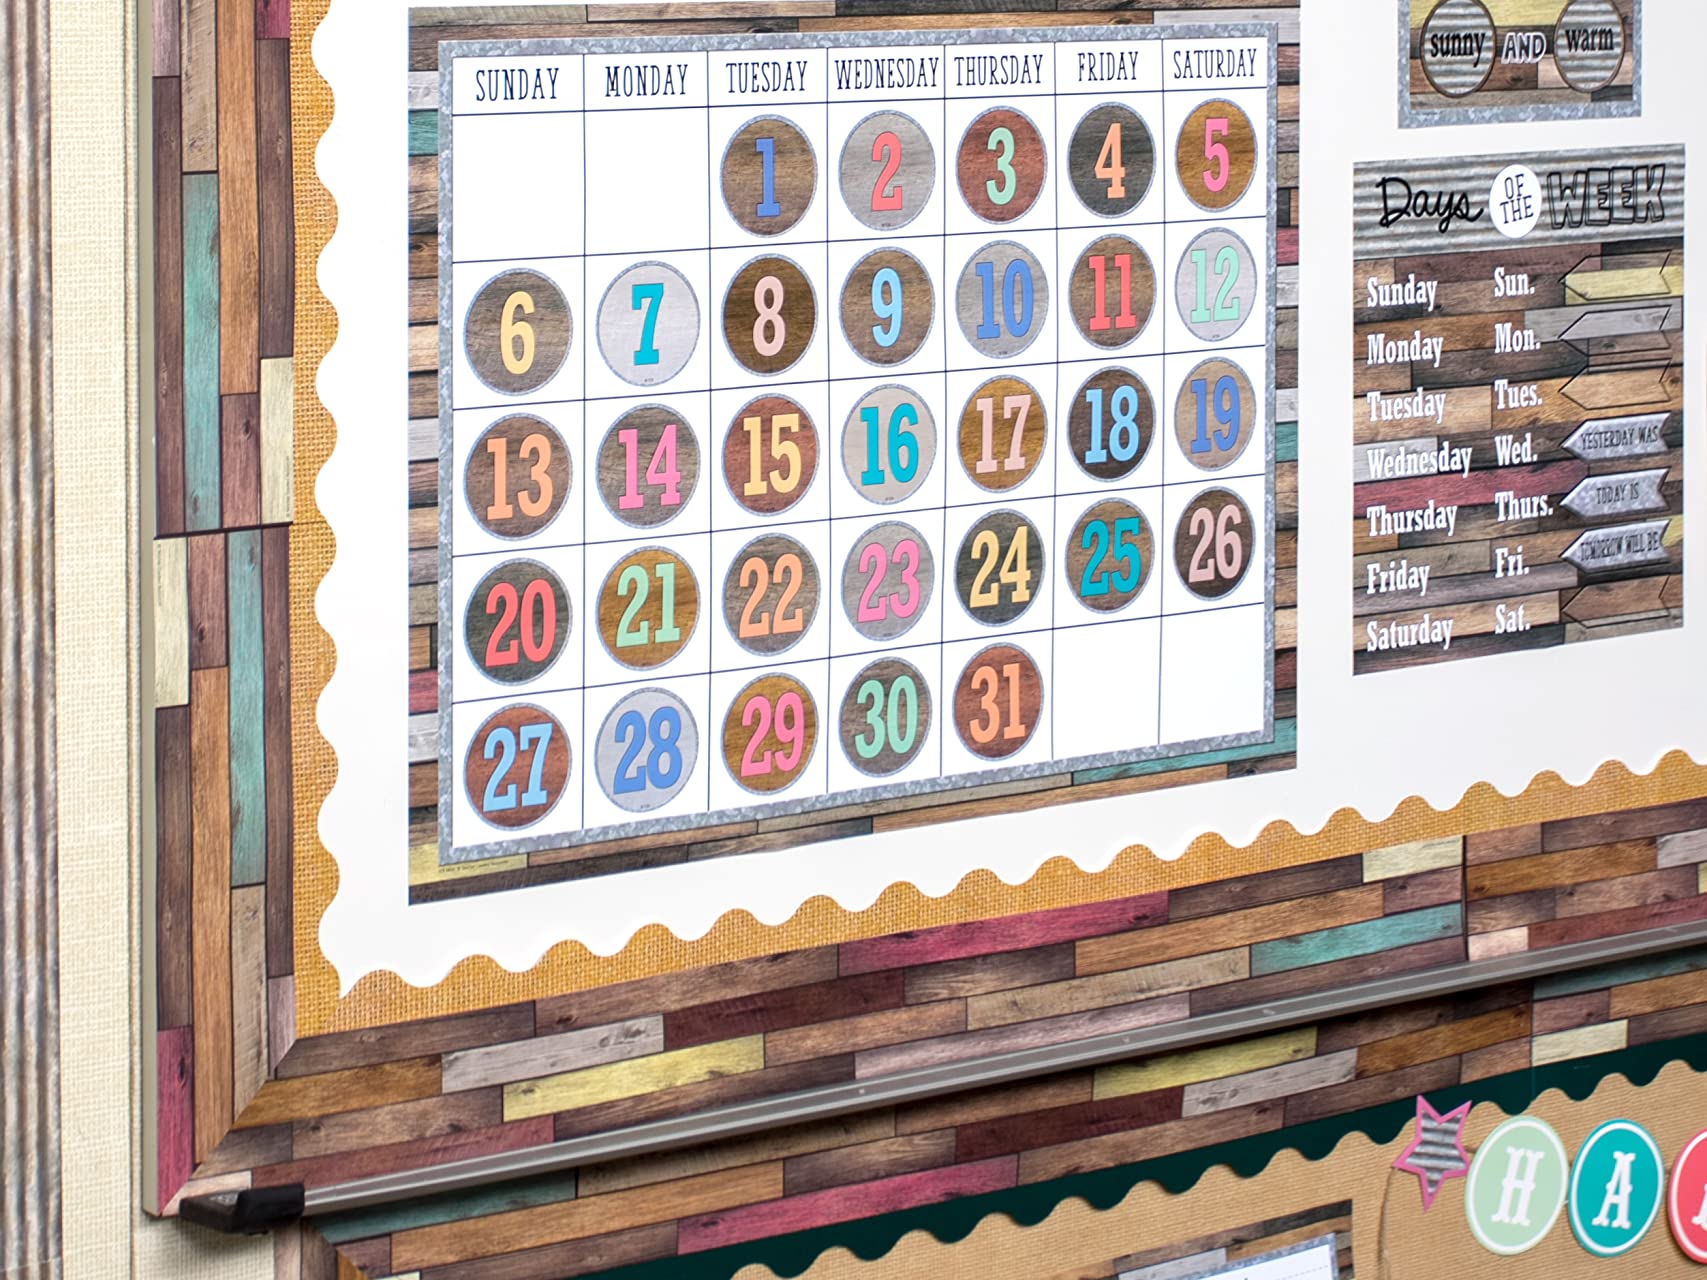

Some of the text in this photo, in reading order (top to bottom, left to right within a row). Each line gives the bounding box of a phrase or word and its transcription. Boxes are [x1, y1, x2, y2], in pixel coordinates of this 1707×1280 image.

[1430, 25, 1615, 68] sunny AND warm
[476, 49, 1257, 101] SUNDAY MONDAY TUESDAY WEDNESDAY THURSDAY FRIDAY SATURDAY
[755, 118, 1229, 217] 1 2 3 4 5
[1503, 173, 1524, 199] OF
[1375, 177, 1484, 234] Days
[1499, 195, 1535, 225] THE
[1546, 163, 1666, 230] WEEK
[500, 245, 1240, 375] 6 7 8 9 10 11 12
[1367, 267, 1535, 312] Sunday Sun.
[1366, 323, 1541, 368] Monday Mon.
[1366, 379, 1543, 424] Tuesday Tues.
[486, 375, 1240, 520] 13 14 15 16 17 18 19
[1367, 432, 1538, 478] Wednesday Wed.
[1581, 425, 1659, 450] YESTERDAY WAS
[1366, 490, 1554, 537] Thursday Thurs.
[1596, 482, 1640, 505] TODAY IS
[1580, 531, 1659, 561] TOMORROW WILL BE
[485, 503, 1242, 667] 20 21 22 23 24 25 26
[1366, 545, 1530, 596] Friday Fri.
[1367, 603, 1531, 652] Saturday Sat.
[482, 662, 1026, 812] 27 28 29 30 31
[1491, 1146, 1707, 1230] HA
